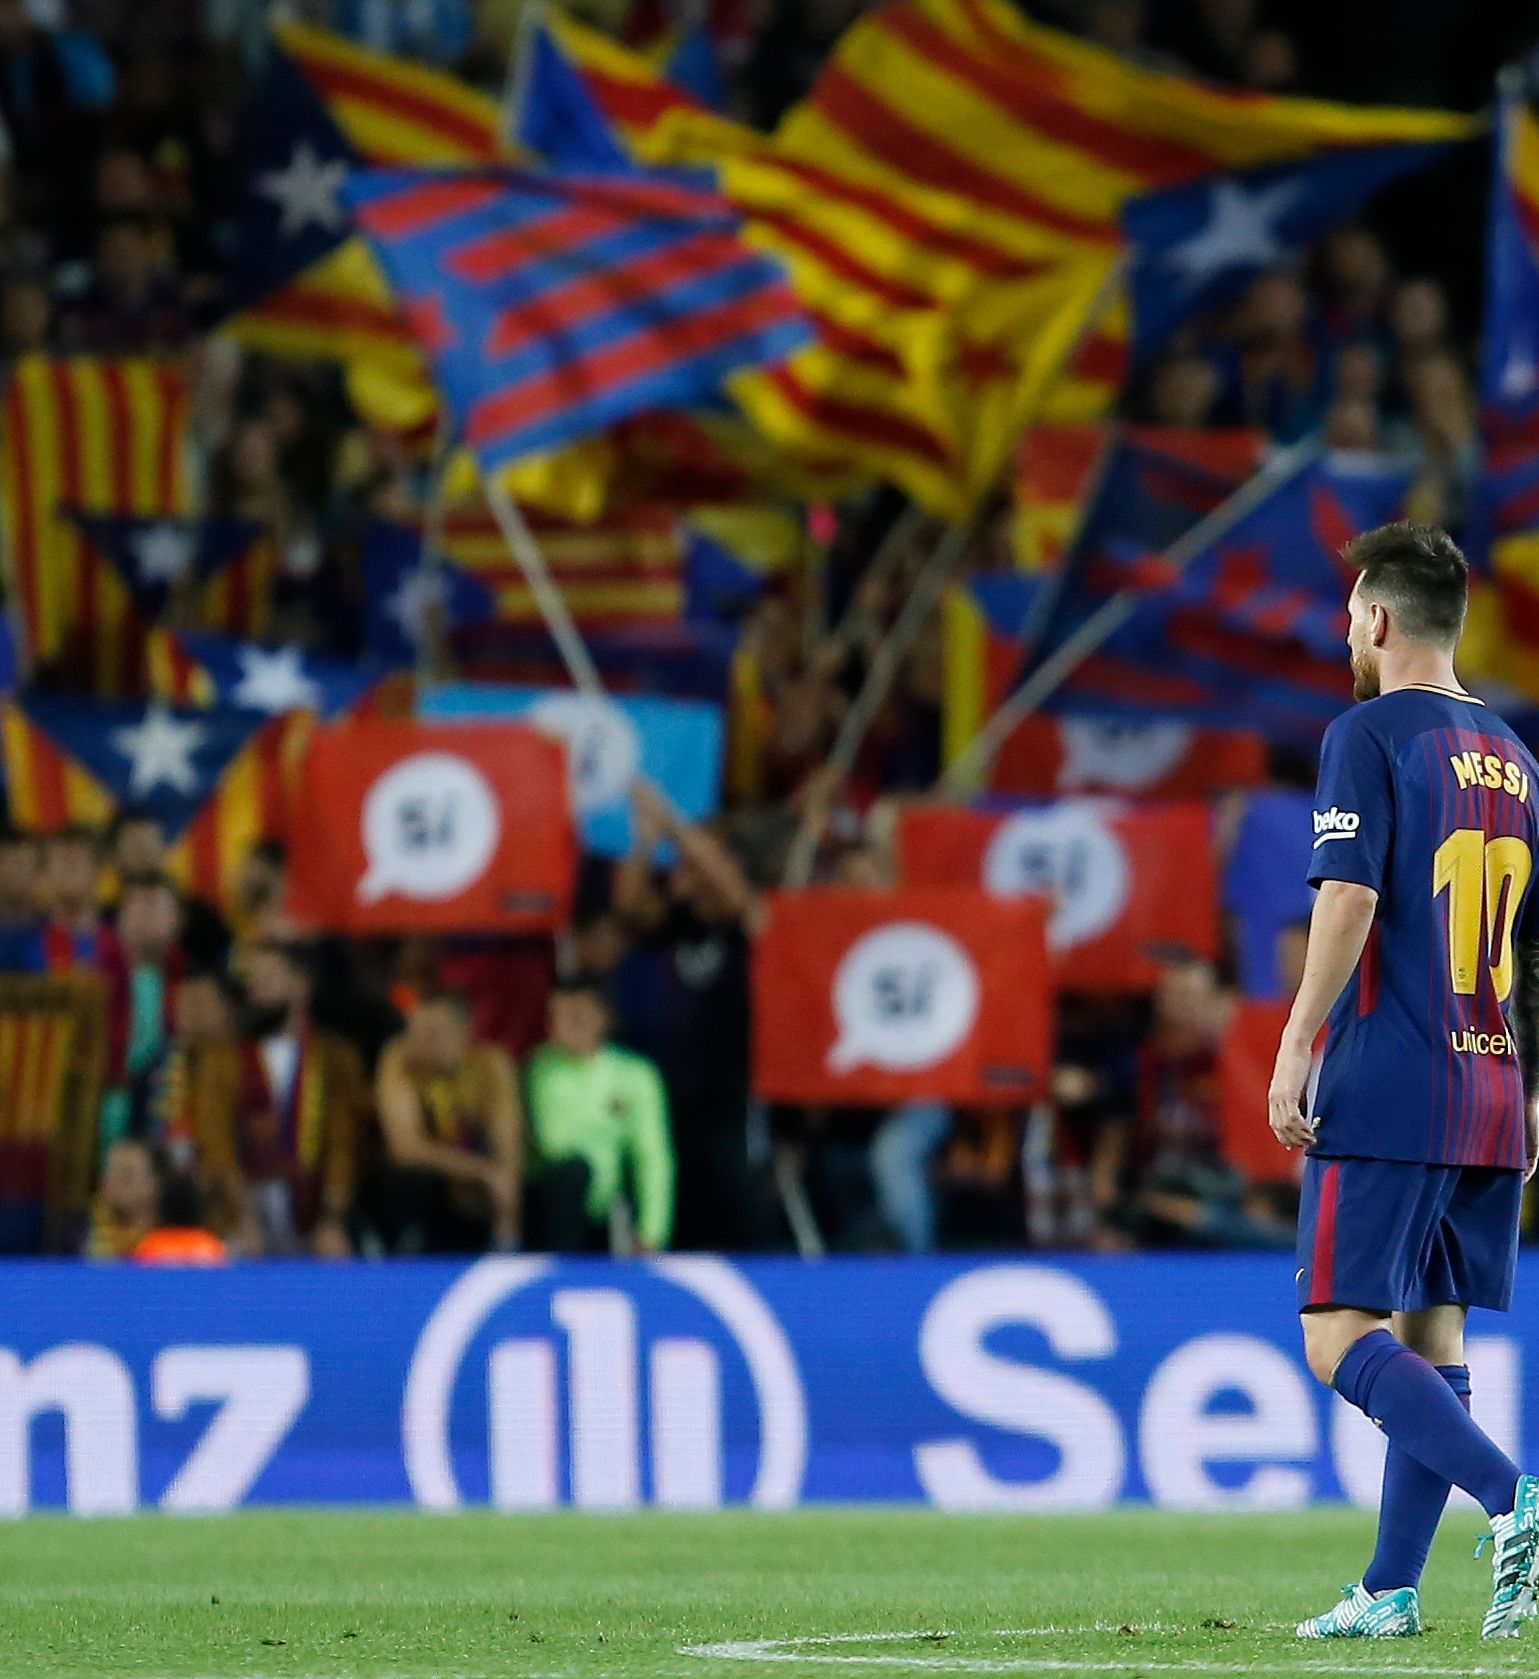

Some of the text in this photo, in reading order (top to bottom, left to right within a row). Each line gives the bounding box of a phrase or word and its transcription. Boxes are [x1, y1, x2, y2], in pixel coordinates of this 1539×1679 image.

[1450, 752, 1529, 803] MESSI
[1312, 806, 1361, 833] beko
[1432, 828, 1533, 1002] 10
